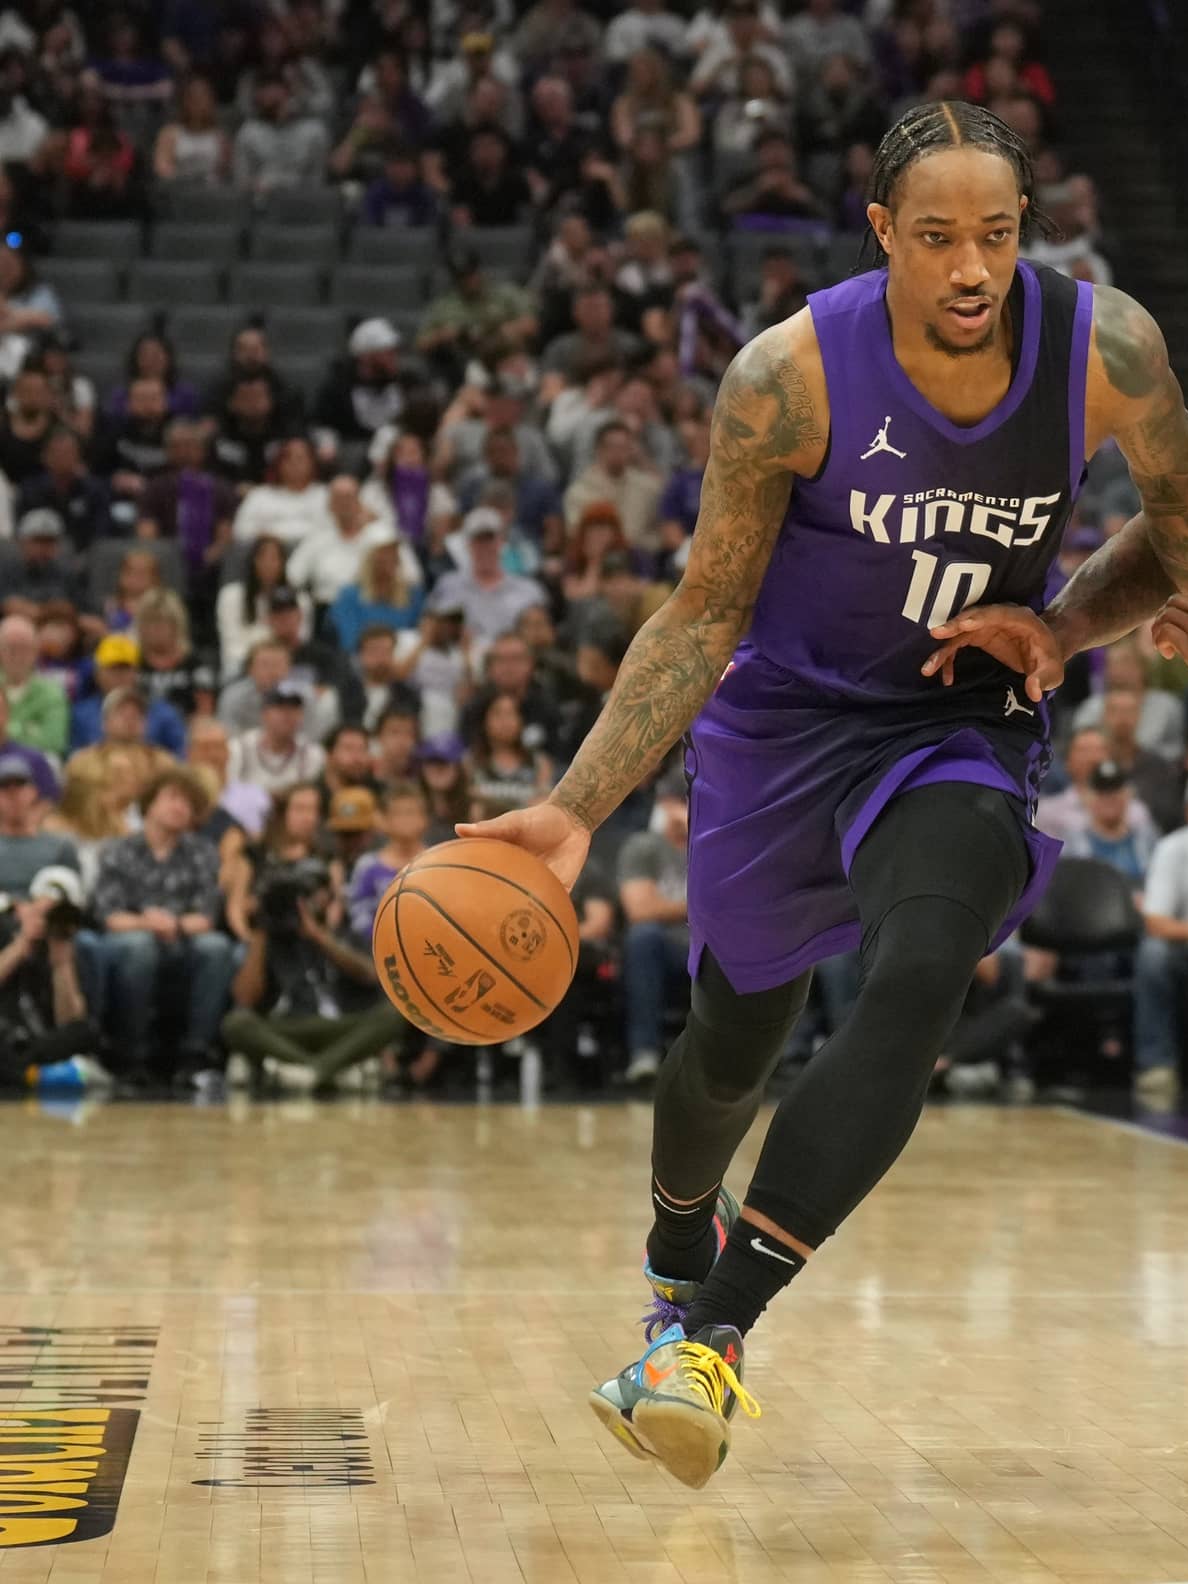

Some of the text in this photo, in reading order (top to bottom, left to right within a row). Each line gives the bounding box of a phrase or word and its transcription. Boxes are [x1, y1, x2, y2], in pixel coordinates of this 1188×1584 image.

[850, 488, 1061, 549] KINGS
[903, 487, 1020, 508] SACRAMENTO
[902, 549, 991, 631] 10
[191, 1407, 377, 1487] Credit Union
